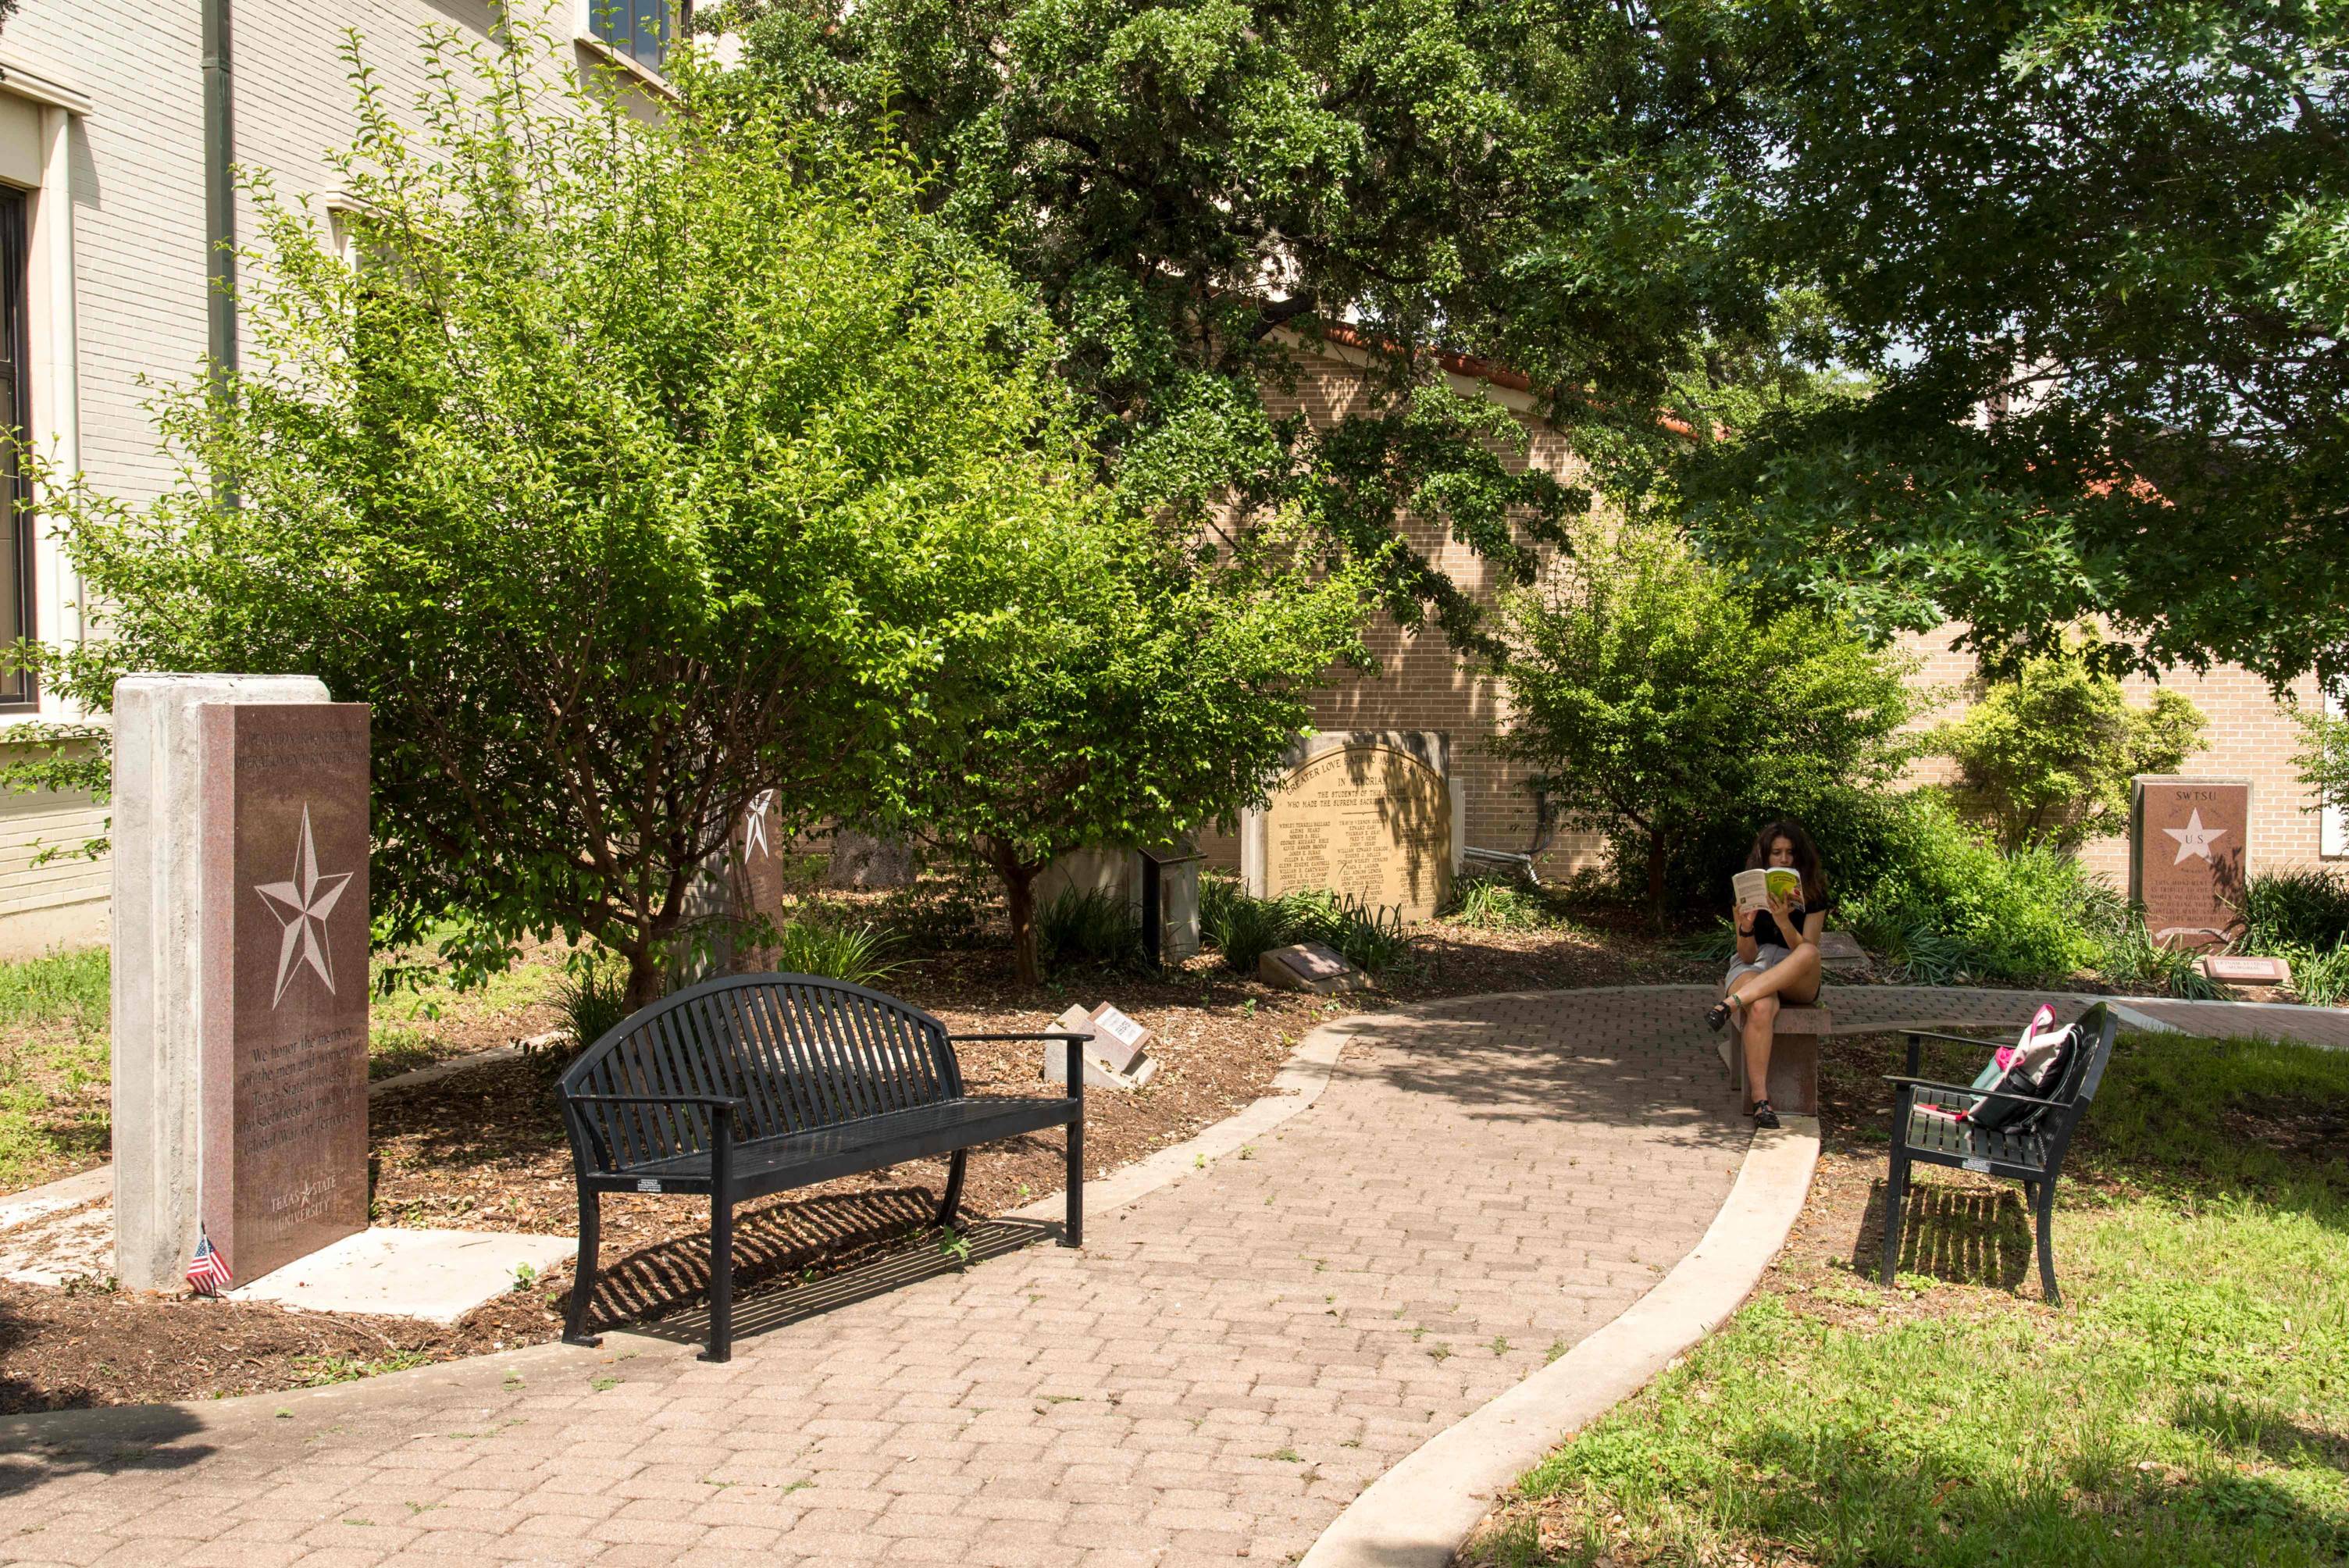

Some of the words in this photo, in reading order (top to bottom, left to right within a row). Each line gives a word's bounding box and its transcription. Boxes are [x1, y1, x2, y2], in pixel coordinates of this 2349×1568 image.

[1285, 768, 1320, 796] GREATER
[1321, 758, 1342, 774] LOVE
[1343, 755, 1363, 765] HATH
[1367, 755, 1377, 764] NO
[1338, 778, 1346, 787] IN
[1350, 776, 1388, 787] MEMORIAM
[1303, 800, 1317, 808] MADE
[1333, 798, 1357, 807] SUPREME
[1331, 789, 1359, 798] STUDENTS
[2176, 790, 2216, 801] SWTSU
[2185, 834, 2193, 843] U
[2198, 834, 2204, 843] S
[253, 1048, 267, 1063] We
[271, 1042, 298, 1059] honor
[300, 1035, 314, 1050] the
[319, 1027, 351, 1046] memory
[243, 1071, 255, 1088] of
[258, 1067, 273, 1084] the
[276, 1064, 295, 1079] men
[298, 1053, 315, 1073] and
[319, 1047, 348, 1064] women
[352, 1039, 362, 1055] of
[253, 1091, 279, 1107] Texas
[282, 1082, 305, 1099] State
[308, 1067, 351, 1089] University
[235, 1118, 255, 1135] who
[258, 1100, 301, 1127] sacrificed
[315, 1091, 337, 1109] much
[245, 1132, 276, 1156] Global
[280, 1128, 298, 1143] War
[301, 1123, 313, 1136] on
[272, 1189, 301, 1213] TEXAS
[312, 1174, 337, 1196] STATE
[278, 1198, 330, 1231] UNIVERSITY
